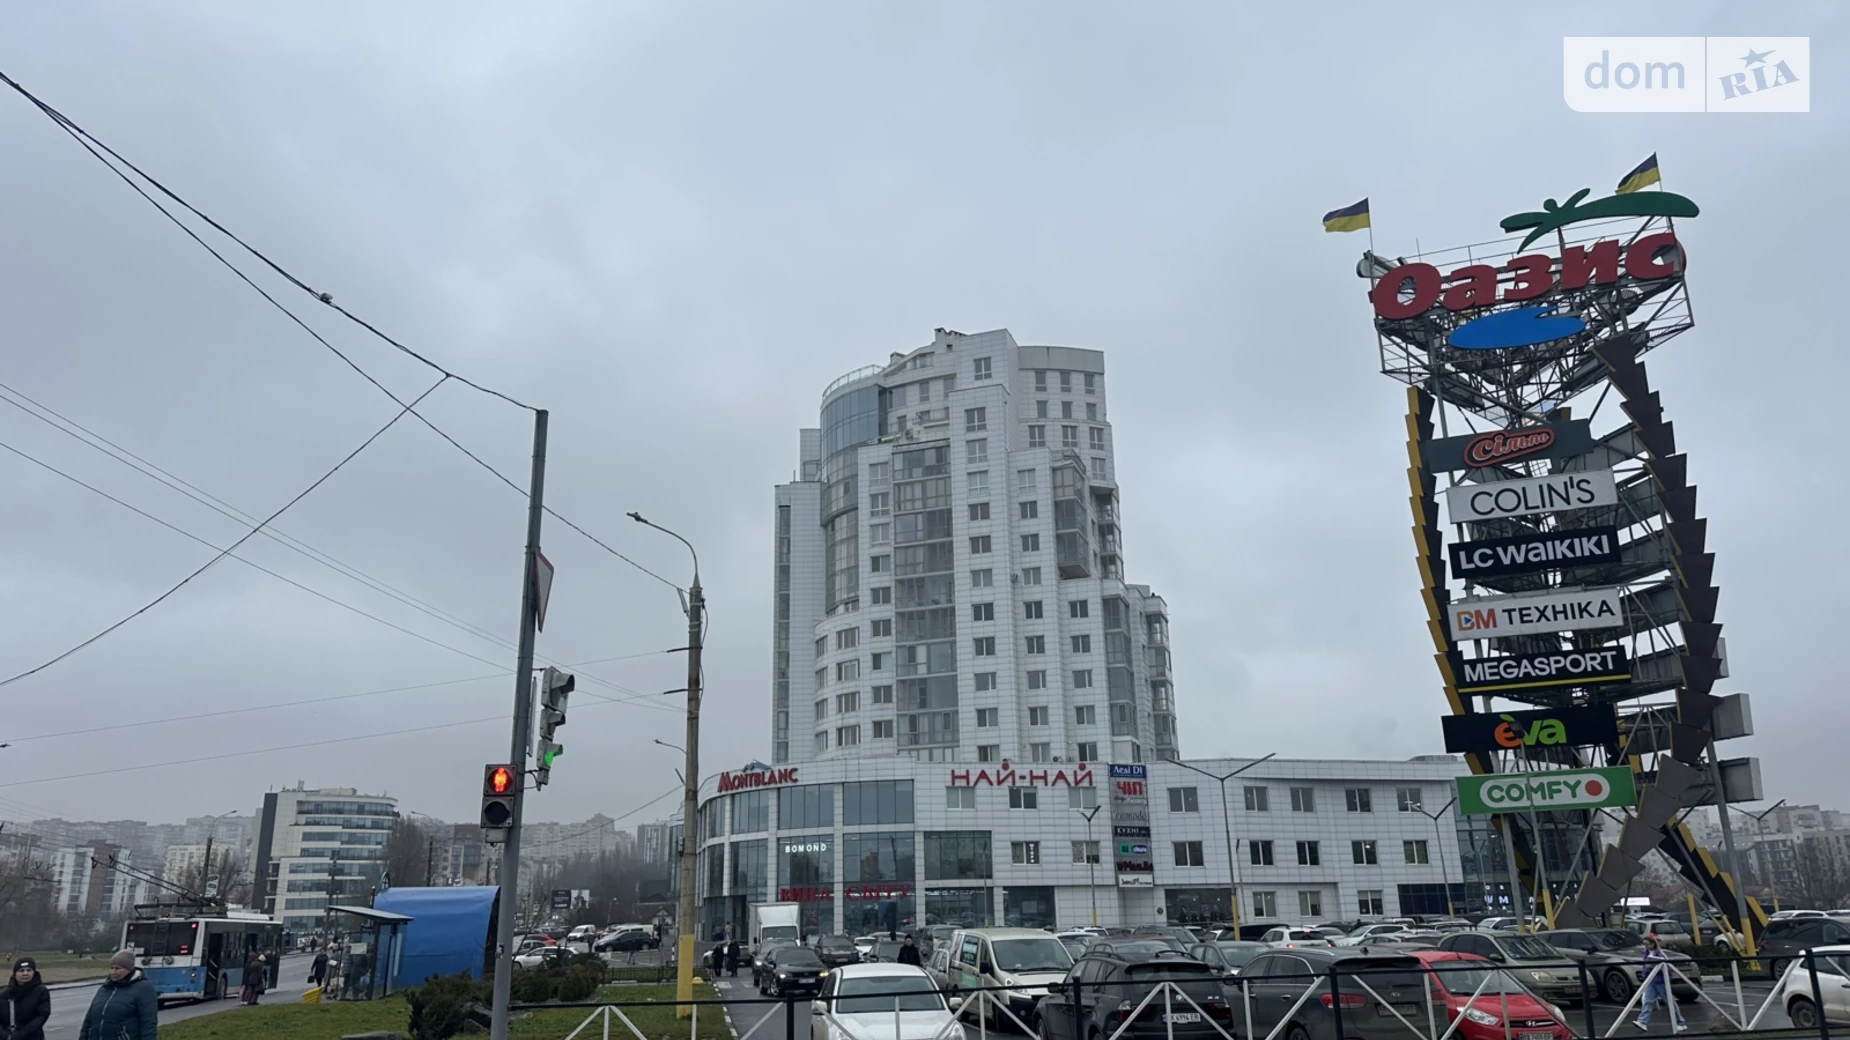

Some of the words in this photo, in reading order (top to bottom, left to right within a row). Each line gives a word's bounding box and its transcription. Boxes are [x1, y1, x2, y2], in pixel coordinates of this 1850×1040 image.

[1371, 233, 1687, 320] Оазис
[1472, 431, 1550, 461] Сільпо
[1470, 476, 1595, 516] COLIN'S
[1459, 548, 1494, 570] LC
[1502, 600, 1616, 626] ТЕХНІКА
[1463, 651, 1617, 683] MEGASPORT
[951, 763, 1094, 787] НАЙ-НАЙ
[1116, 781, 1143, 796] ЧІП
[1487, 780, 1582, 804] COMFY
[785, 843, 827, 854] BOMOND
